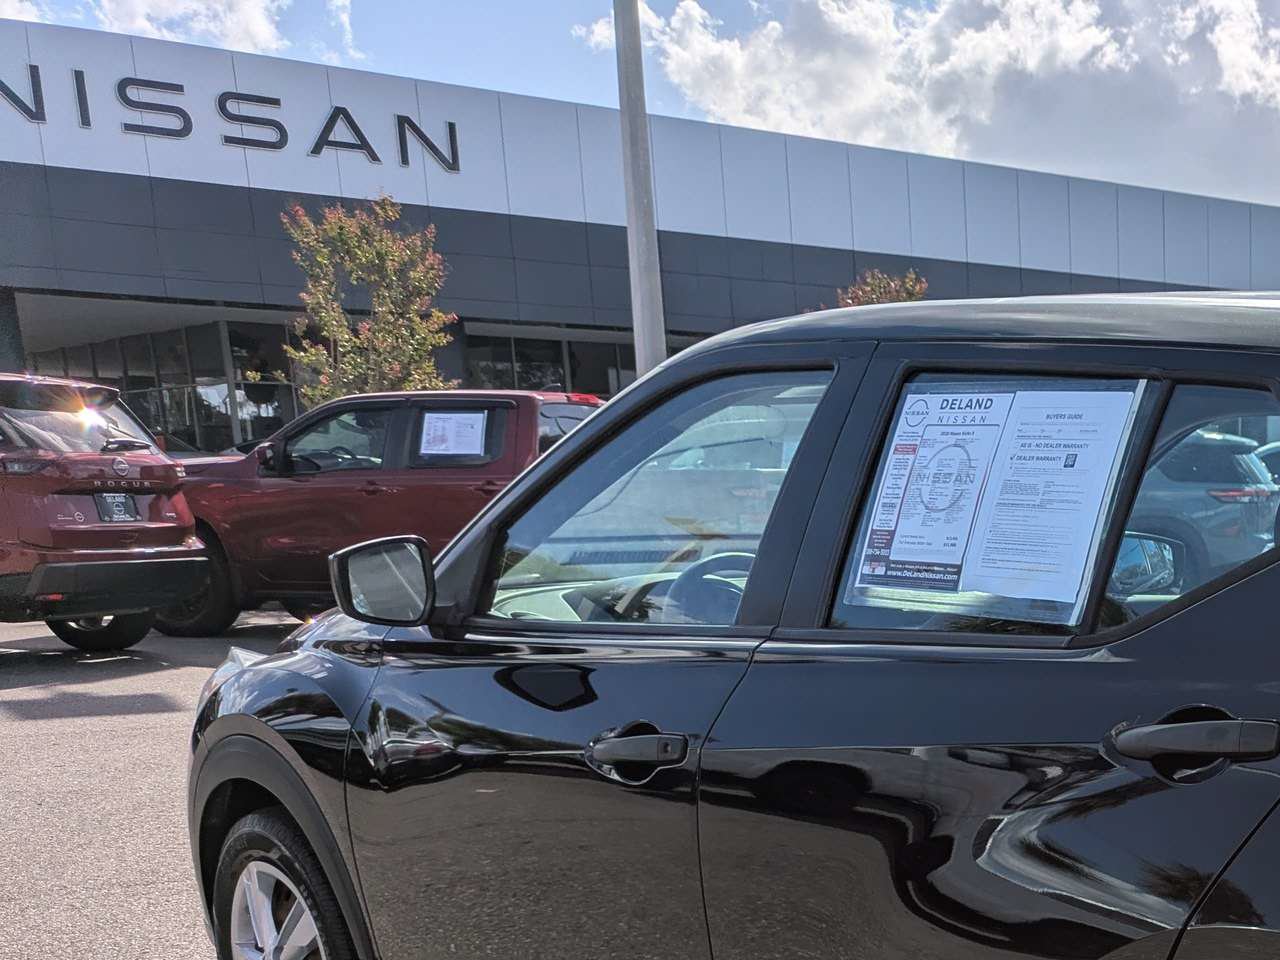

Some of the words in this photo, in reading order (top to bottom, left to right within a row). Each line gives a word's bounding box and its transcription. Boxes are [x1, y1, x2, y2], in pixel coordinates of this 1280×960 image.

[0, 63, 461, 174] NISSAN
[939, 398, 994, 410] DELAND
[937, 415, 987, 424] NISSAN
[912, 471, 976, 485] NISSAN
